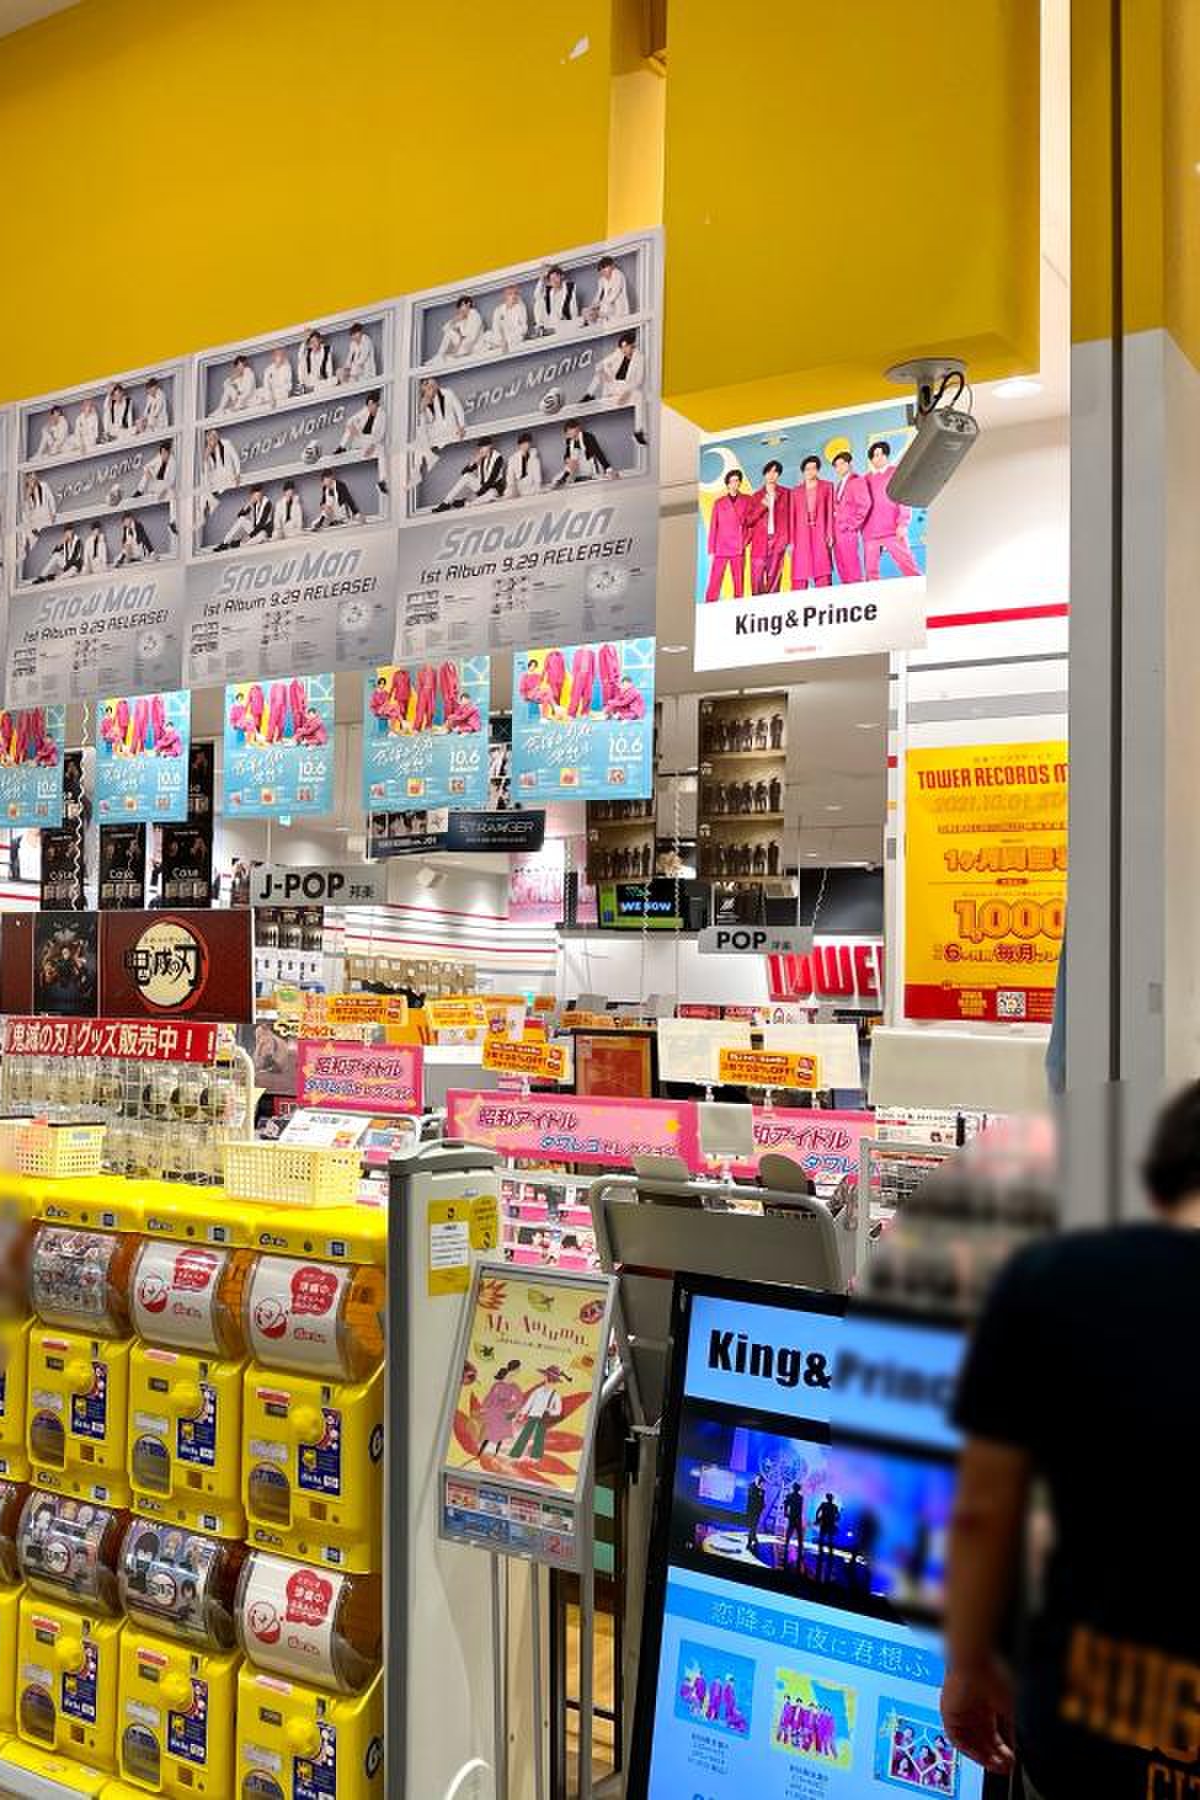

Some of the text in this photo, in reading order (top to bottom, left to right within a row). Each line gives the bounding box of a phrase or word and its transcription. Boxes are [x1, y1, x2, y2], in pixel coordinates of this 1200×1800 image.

[437, 506, 616, 559] Snow Man
[298, 548, 363, 583] Man
[420, 537, 634, 586] 1st Album 9.29 RELEASE!
[450, 749, 481, 765] 10.6
[608, 736, 643, 754] 10.6
[298, 760, 327, 777] 10.6
[918, 768, 972, 790] TOWER
[975, 764, 1050, 787] RECORDS
[259, 871, 345, 899] J-POP
[716, 930, 767, 949] POP
[478, 1105, 578, 1132] 昭和アイドル
[753, 1123, 851, 1151] 和アイドル
[711, 1600, 931, 1679] 恋降る月夜に君想ふ
